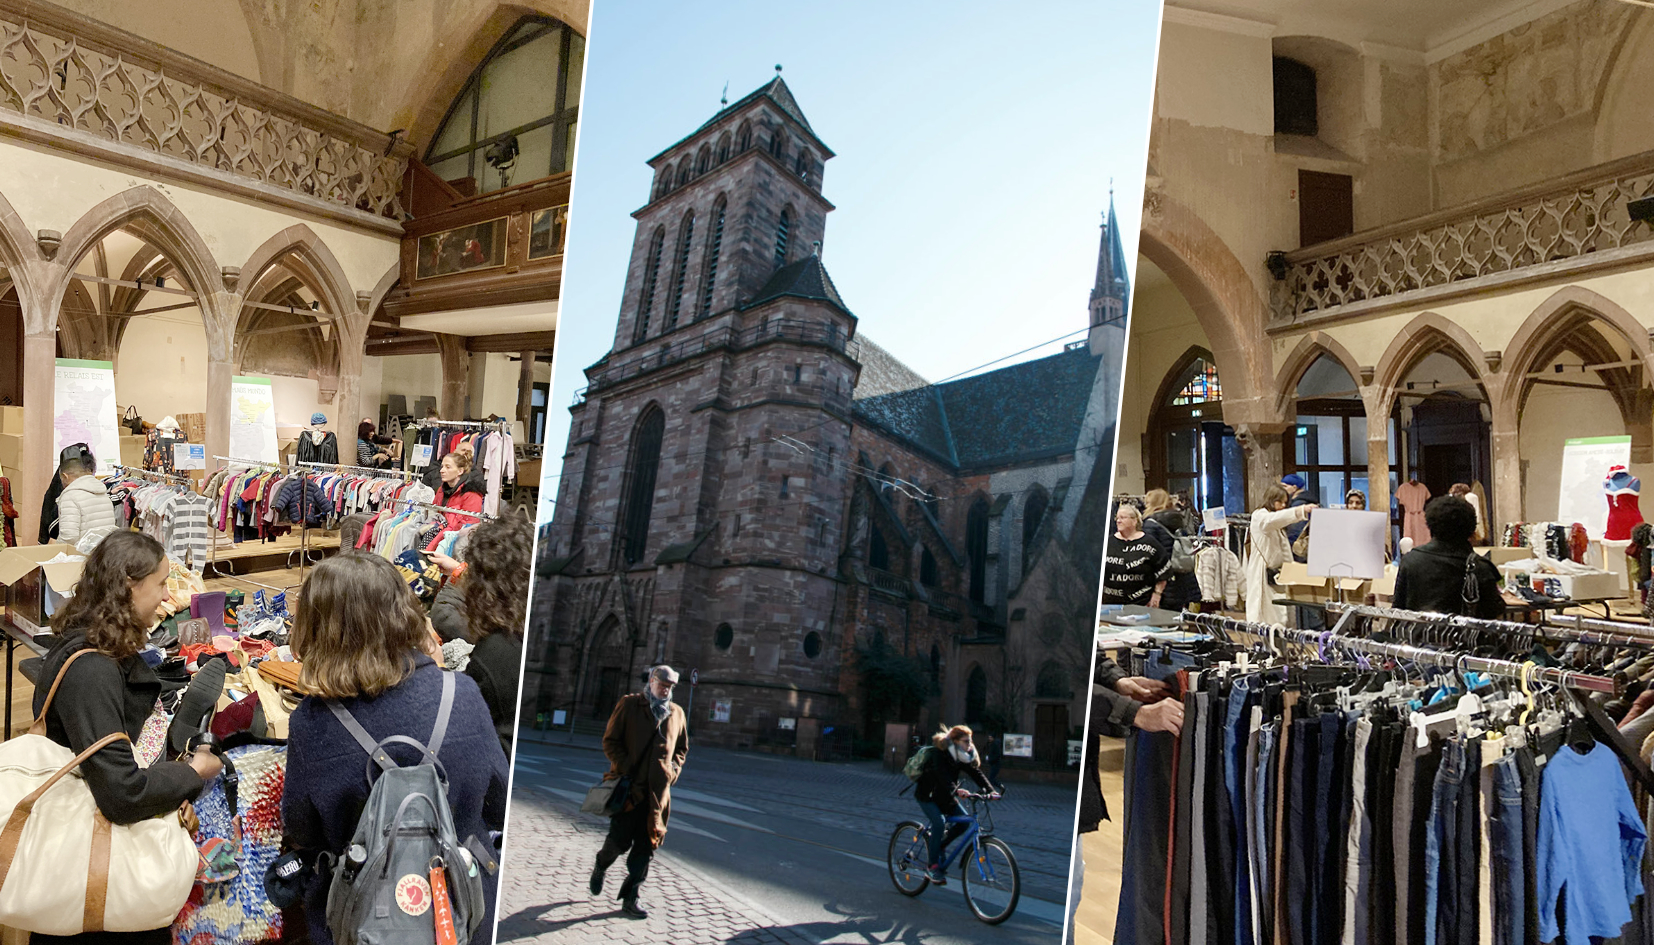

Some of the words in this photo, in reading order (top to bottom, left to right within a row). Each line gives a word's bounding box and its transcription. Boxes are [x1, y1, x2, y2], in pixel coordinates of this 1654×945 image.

[64, 371, 89, 380] RELAIS
[92, 372, 104, 380] EST
[1122, 544, 1157, 556] J'ADORE
